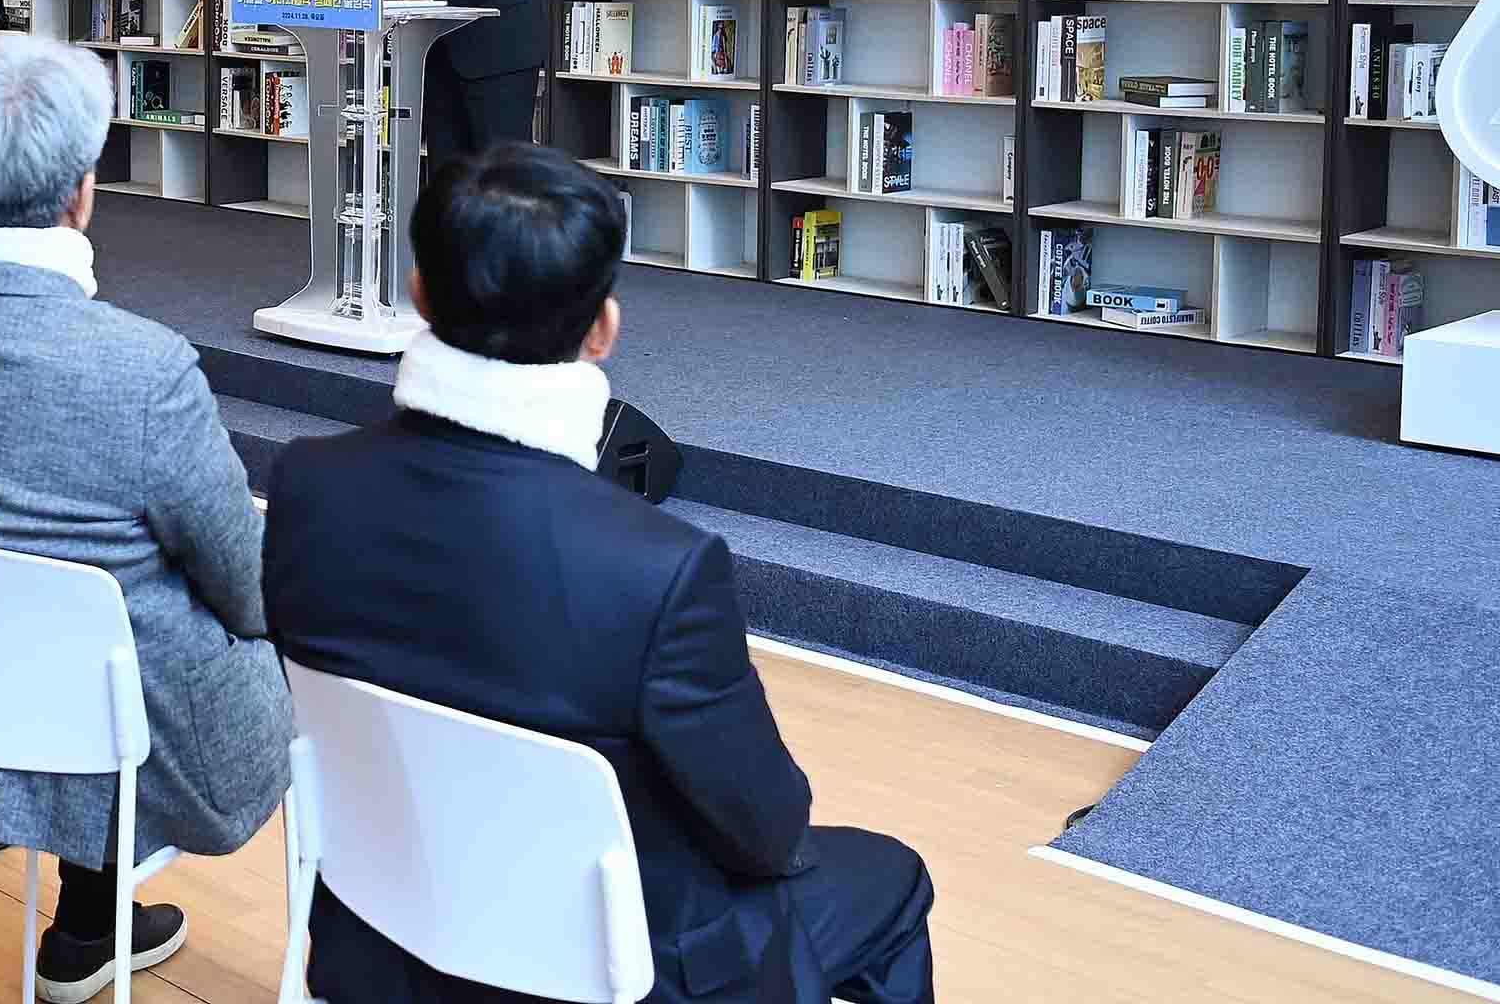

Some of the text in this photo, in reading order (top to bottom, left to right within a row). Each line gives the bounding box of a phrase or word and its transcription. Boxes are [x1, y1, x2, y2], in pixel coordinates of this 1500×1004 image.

[1065, 19, 1075, 54] SPACE
[1077, 17, 1107, 33] space
[964, 43, 973, 85] CHANEL
[1268, 52, 1277, 76] HOTEL
[1267, 77, 1276, 100] BOOK
[1415, 61, 1424, 93] Company
[146, 114, 176, 122] ANIMALS
[630, 111, 639, 161] DREAMS
[685, 124, 693, 151] BEST
[1164, 146, 1172, 166] BOOK
[1054, 243, 1063, 304] COFFEE BOOK
[1093, 294, 1133, 308] BOOK
